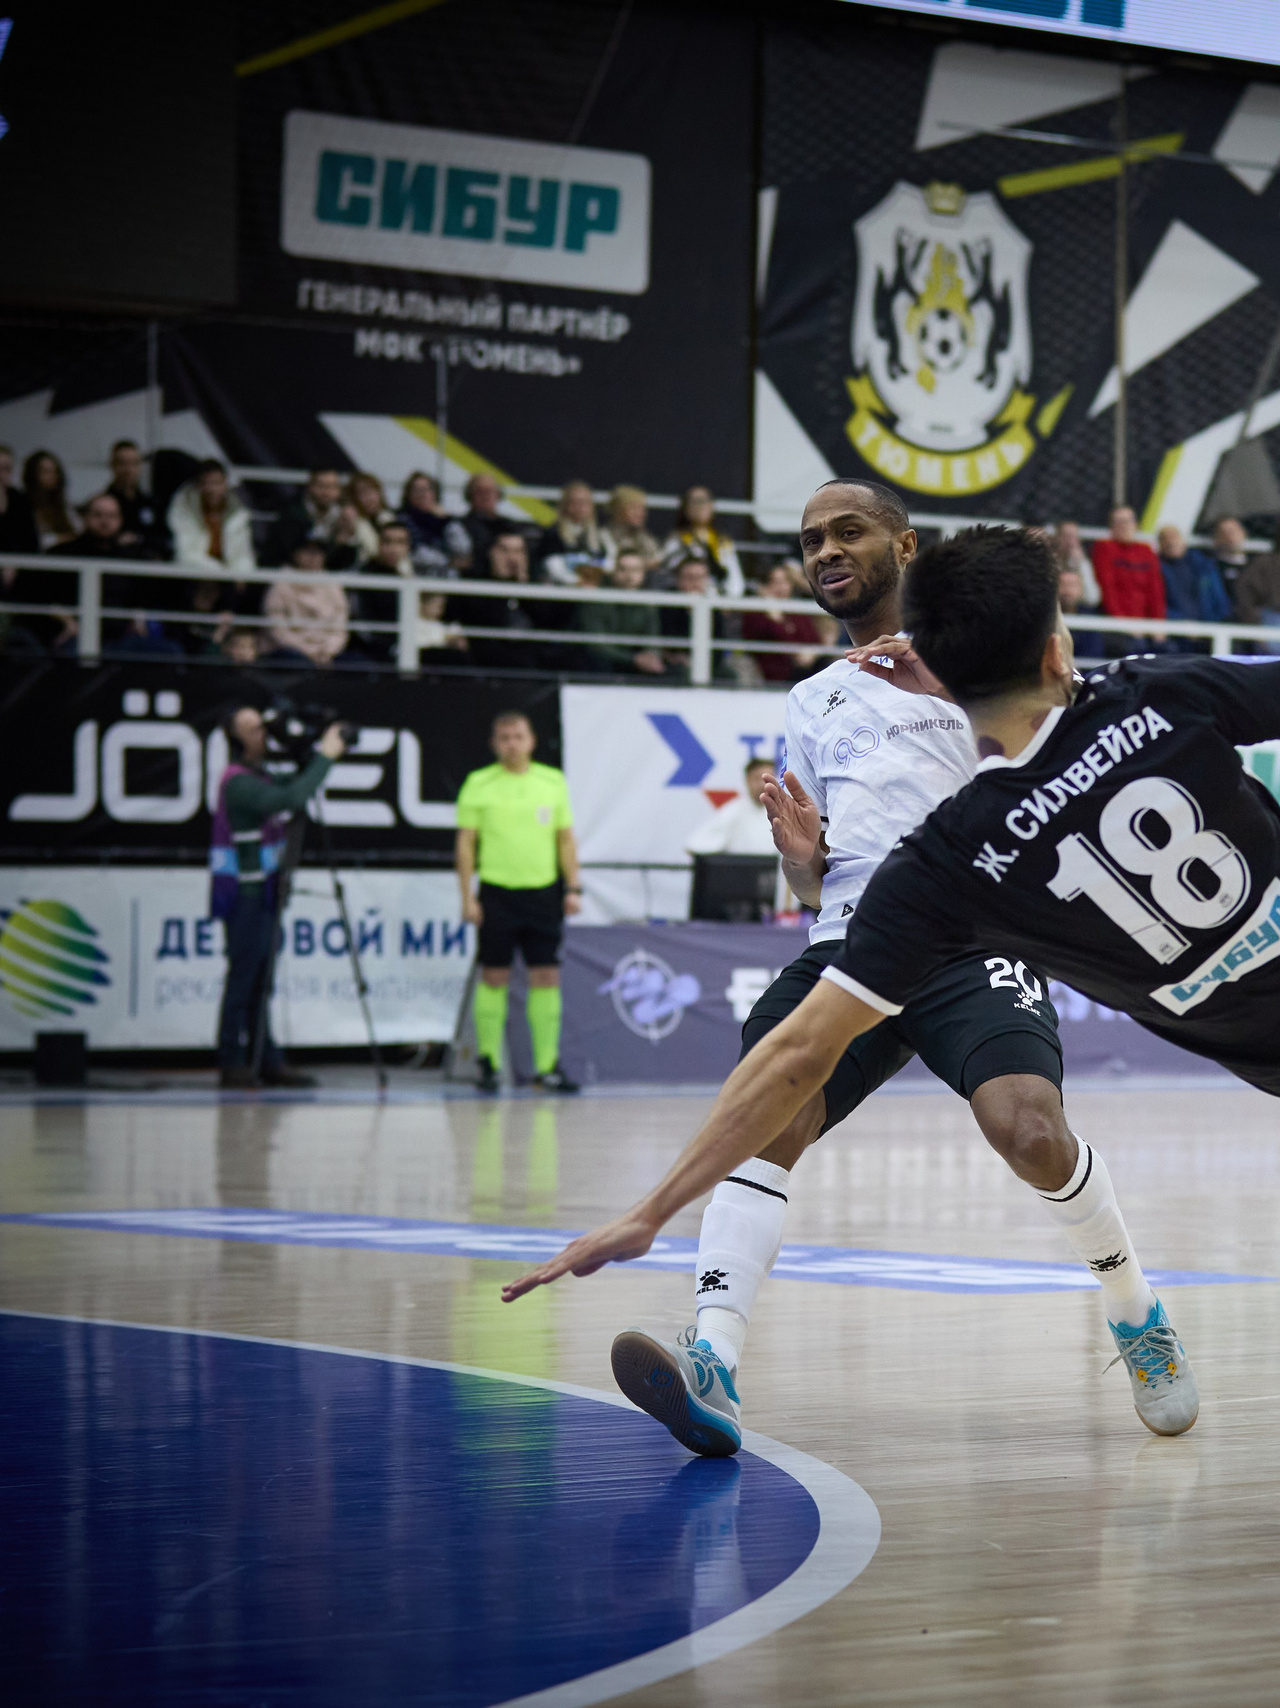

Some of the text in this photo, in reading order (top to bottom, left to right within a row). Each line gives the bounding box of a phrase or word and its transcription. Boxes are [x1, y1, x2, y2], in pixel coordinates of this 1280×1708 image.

[314, 149, 621, 252] СИБУР
[298, 279, 631, 341] ГЕНЕРАЛЬНЫЙ ПАРТНЁР
[857, 419, 1026, 490] ТЮМЕНЬ
[822, 697, 847, 718] KELME
[886, 718, 964, 741] НОРНИКЕЛЬ
[972, 841, 1020, 883] Ж.
[1005, 706, 1174, 840] СИЛВЕЙРА
[1046, 776, 1251, 965] 18
[157, 908, 468, 960] ДЕВОЙ МИ
[983, 957, 1043, 1002] 20
[1013, 1002, 1041, 1017] KELME
[696, 1284, 729, 1296] KELME
